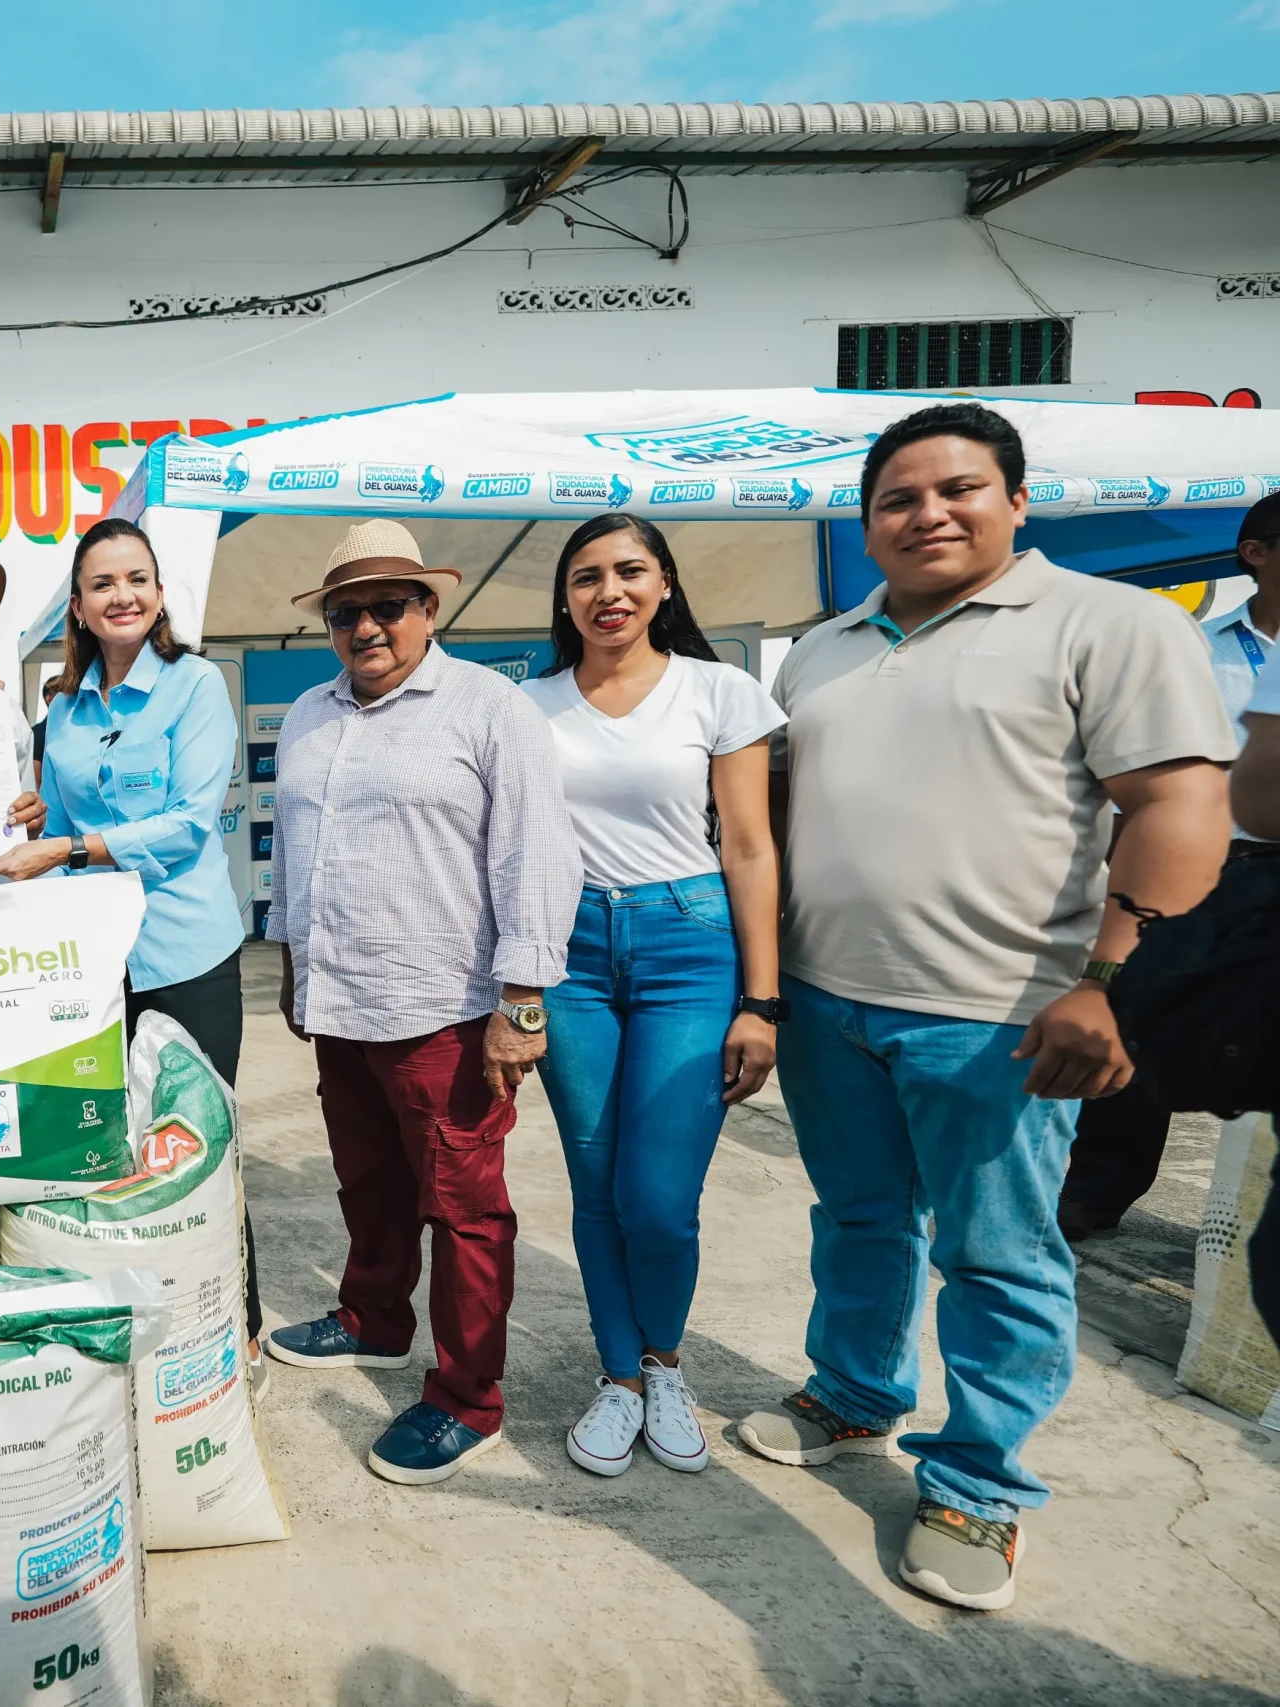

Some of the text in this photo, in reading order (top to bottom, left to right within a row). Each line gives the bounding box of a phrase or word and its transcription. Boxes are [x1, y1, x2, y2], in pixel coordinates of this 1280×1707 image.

[167, 472, 222, 483] DEL GUAYAS
[272, 471, 336, 489] CAMBIO
[365, 474, 417, 482] CIUDADANA
[556, 481, 607, 489] CIUDADANA
[364, 482, 417, 491] DEL GUAYAS
[466, 480, 528, 496] CAMBIO
[556, 489, 607, 498] DEL GUAYAS
[653, 485, 712, 501] CAMBIO
[740, 485, 788, 493] CIUDADANA
[1028, 485, 1061, 502] MBIO
[1189, 481, 1243, 500] CAMBIO
[739, 493, 754, 501] DEL
[831, 491, 862, 506] CAM
[1100, 491, 1147, 499] DEL GUAYAS
[489, 663, 526, 679] BIO
[38, 970, 83, 983] AGRO
[26, 1209, 207, 1240] NITRO N38 ACTIVE RADICAL PAC
[45, 1366, 72, 1387] PAC
[165, 1363, 219, 1389] CIDADANA
[155, 1374, 238, 1424] PROHIBIDA SU VENTA
[164, 1385, 184, 1399] DEL
[77, 1437, 92, 1452] 16%
[94, 1431, 104, 1446] p/p
[76, 1469, 85, 1480] 16
[95, 1458, 105, 1471] p/p
[20, 1481, 121, 1540] PRODUCTO GRATUITO
[28, 1527, 98, 1566] PREFECTURA
[27, 1538, 99, 1579] CIUDADANA
[28, 1549, 99, 1590] DEL GUAYAS
[12, 1557, 125, 1623] PROHIBIDA SU VENTA
